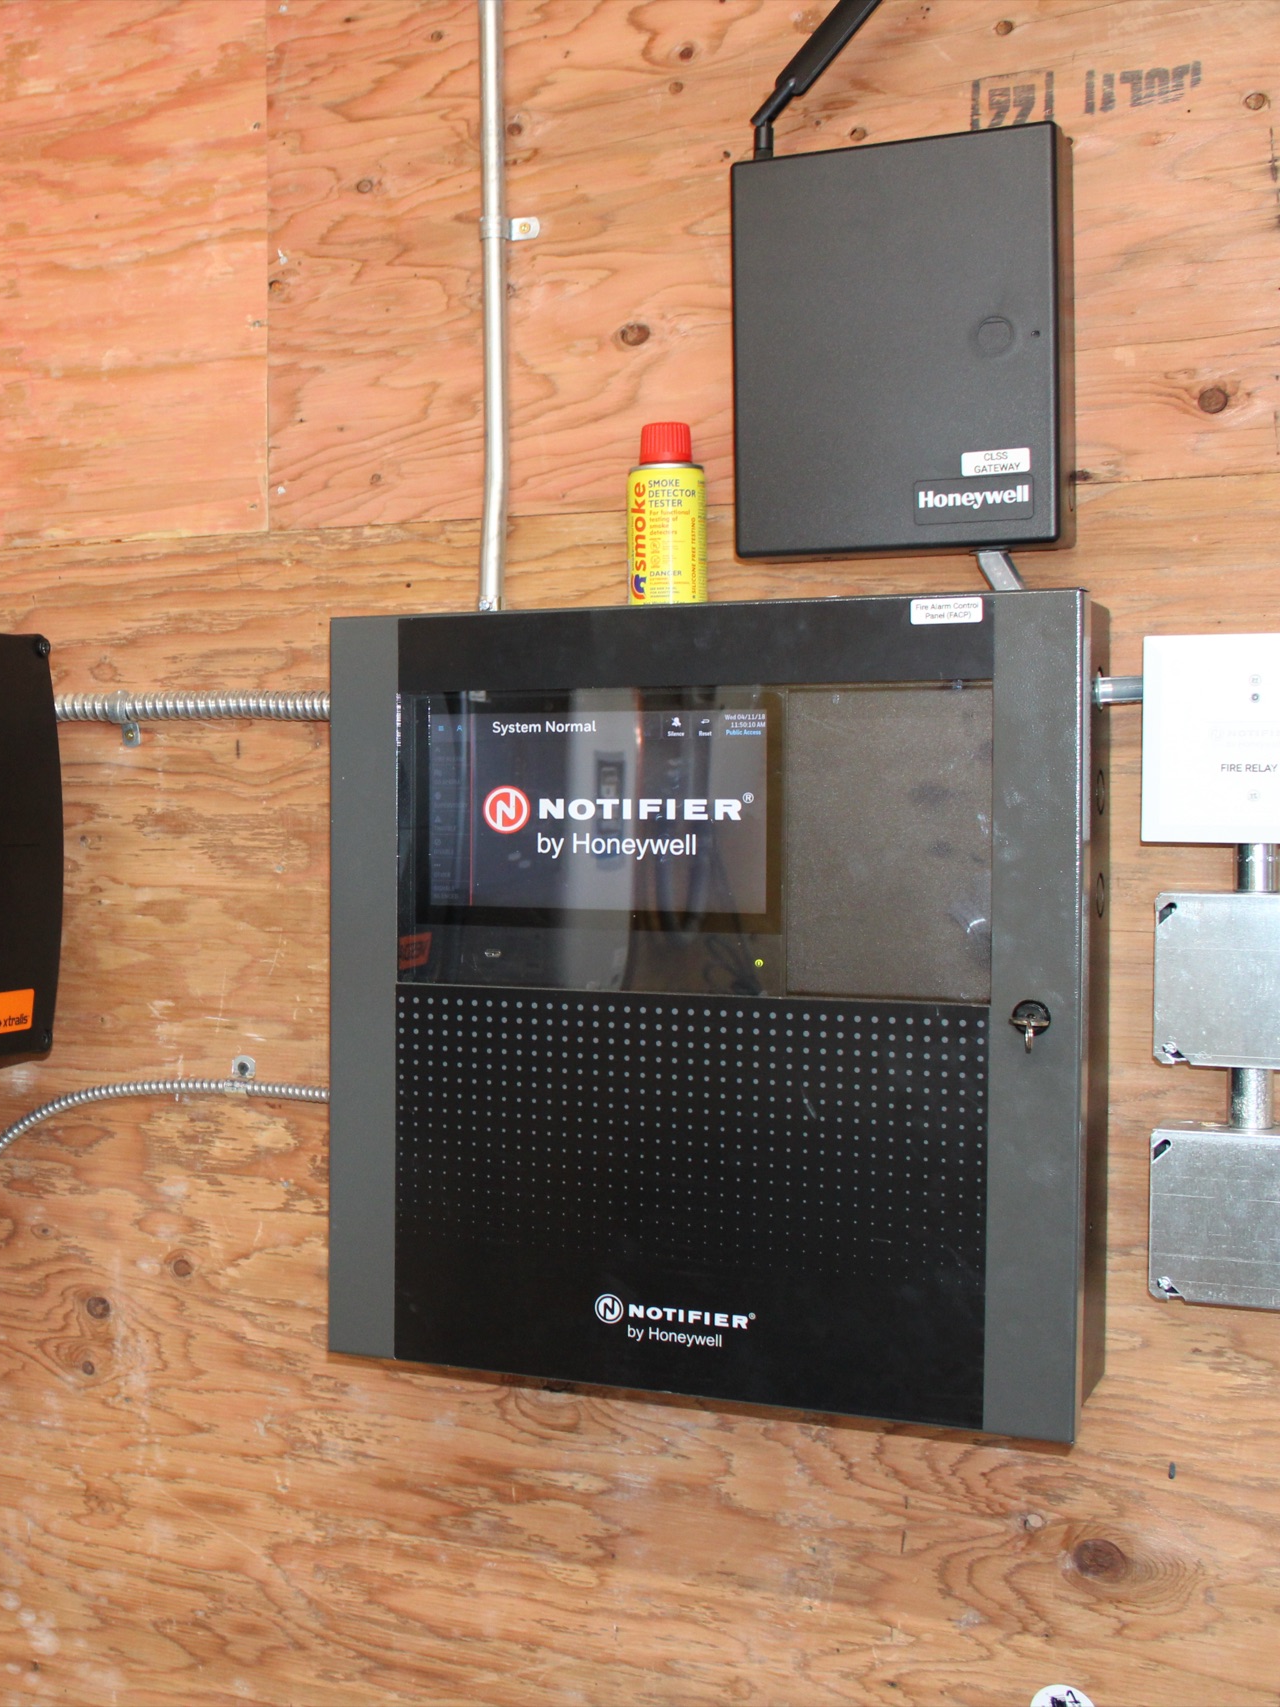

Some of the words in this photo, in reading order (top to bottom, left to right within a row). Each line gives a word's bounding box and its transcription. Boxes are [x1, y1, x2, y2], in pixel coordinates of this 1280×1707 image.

[984, 452, 1008, 461] CLSS
[974, 462, 1021, 473] GATEWAY
[648, 479, 680, 488] SMOKE
[648, 489, 696, 498] DETECTOR
[919, 485, 1029, 509] Honeywell
[648, 499, 683, 508] TESTER
[631, 482, 646, 572] smoke
[947, 611, 972, 619] (FACP)
[492, 721, 542, 736] System
[546, 720, 596, 733] Normal
[1221, 764, 1242, 772] FIRE
[1245, 764, 1277, 772] RELAY
[538, 798, 743, 821] NOTIFIER
[537, 833, 564, 859] by
[572, 833, 697, 860] Honeywell
[2, 1014, 29, 1028] xtralis
[628, 1303, 749, 1330] NOTIFIER
[627, 1324, 644, 1342] by
[648, 1326, 722, 1348] Honeywell
